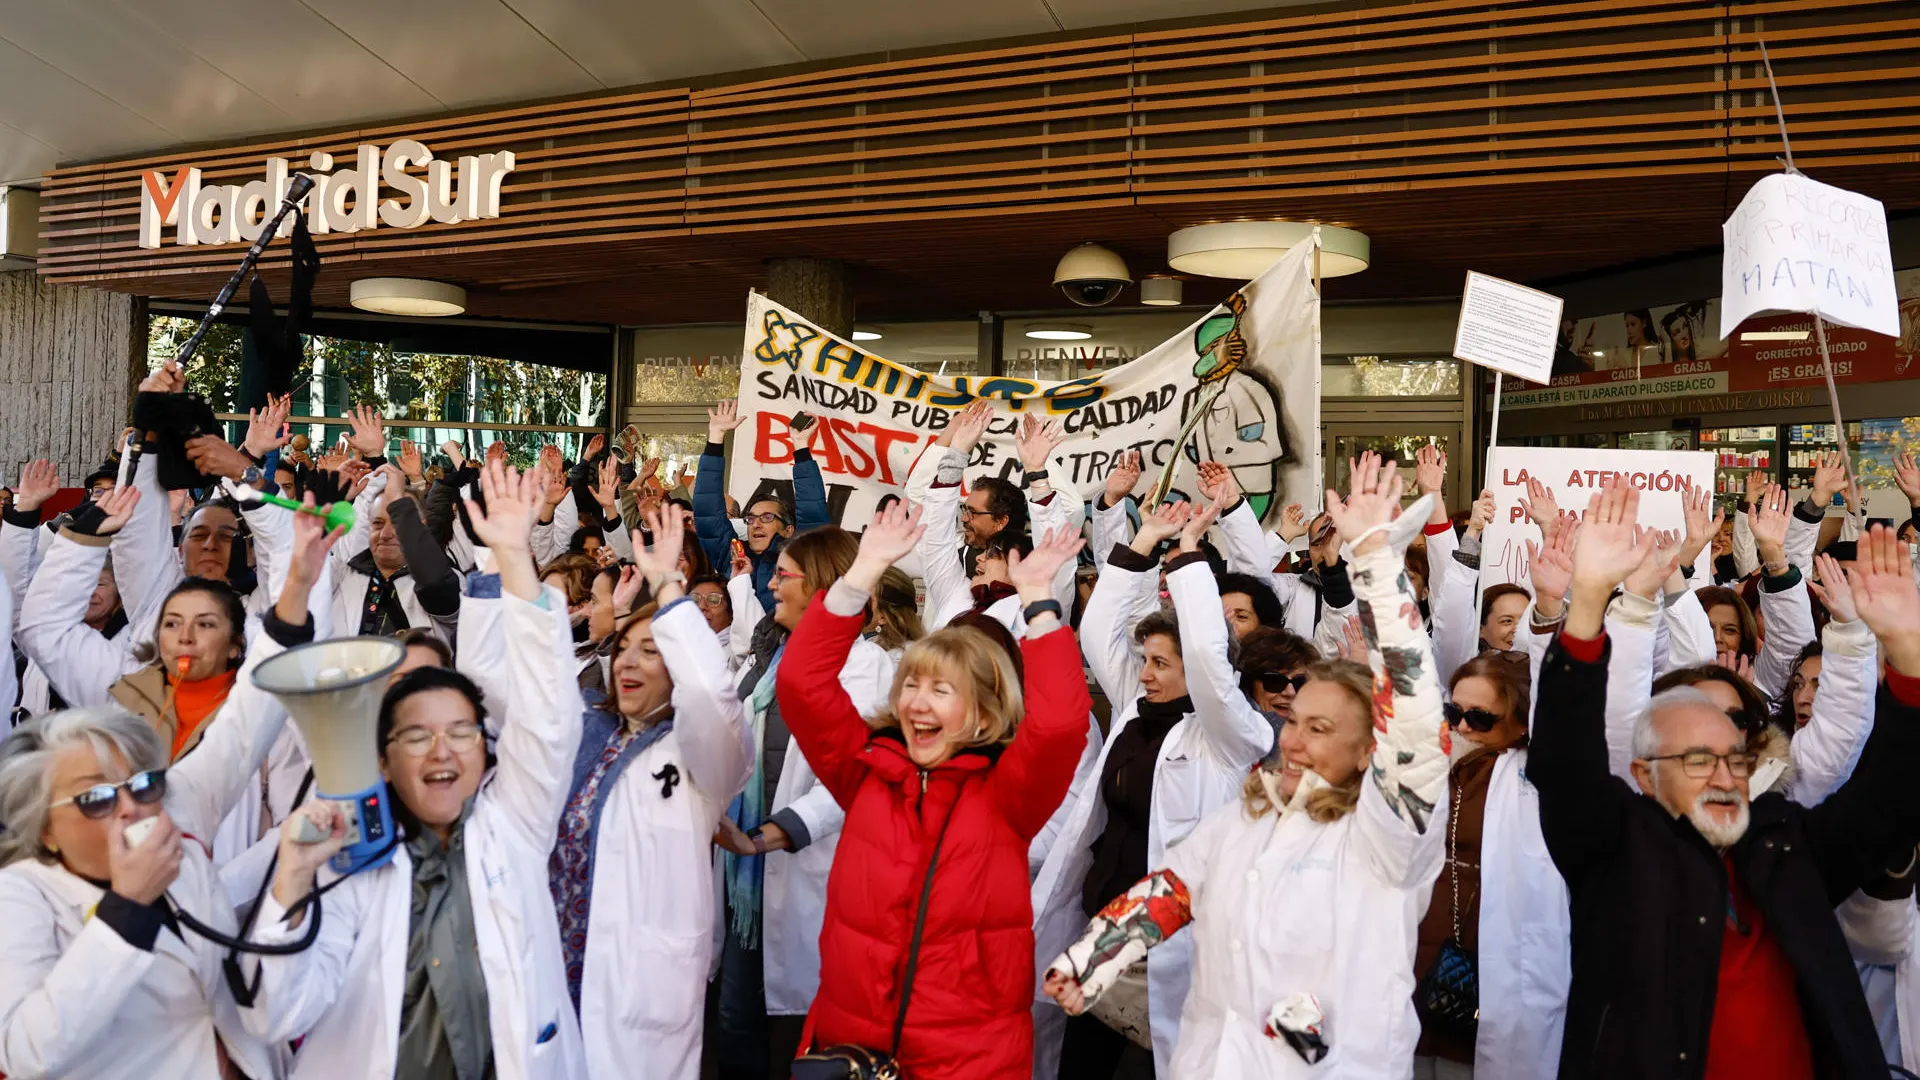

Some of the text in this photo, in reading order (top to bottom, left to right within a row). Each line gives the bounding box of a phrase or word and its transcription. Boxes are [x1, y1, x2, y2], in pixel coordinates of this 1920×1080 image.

[1742, 257, 1872, 308] MATAN
[1755, 347, 1812, 361] CORRECTO
[1674, 361, 1712, 374] GRASA
[1794, 361, 1852, 378] GRAIS!
[1551, 375, 1581, 386] CASPA
[1508, 394, 1536, 404] CAUSA
[1538, 389, 1561, 402] ESTÁ
[1563, 390, 1576, 401] EN
[1577, 388, 1590, 400] TU
[1592, 384, 1638, 398] APARATO
[1639, 376, 1716, 394] PILOSEBÁCEO
[756, 371, 1177, 435] SANIDAD PUBCA CALIDAD
[1503, 468, 1530, 486] LA
